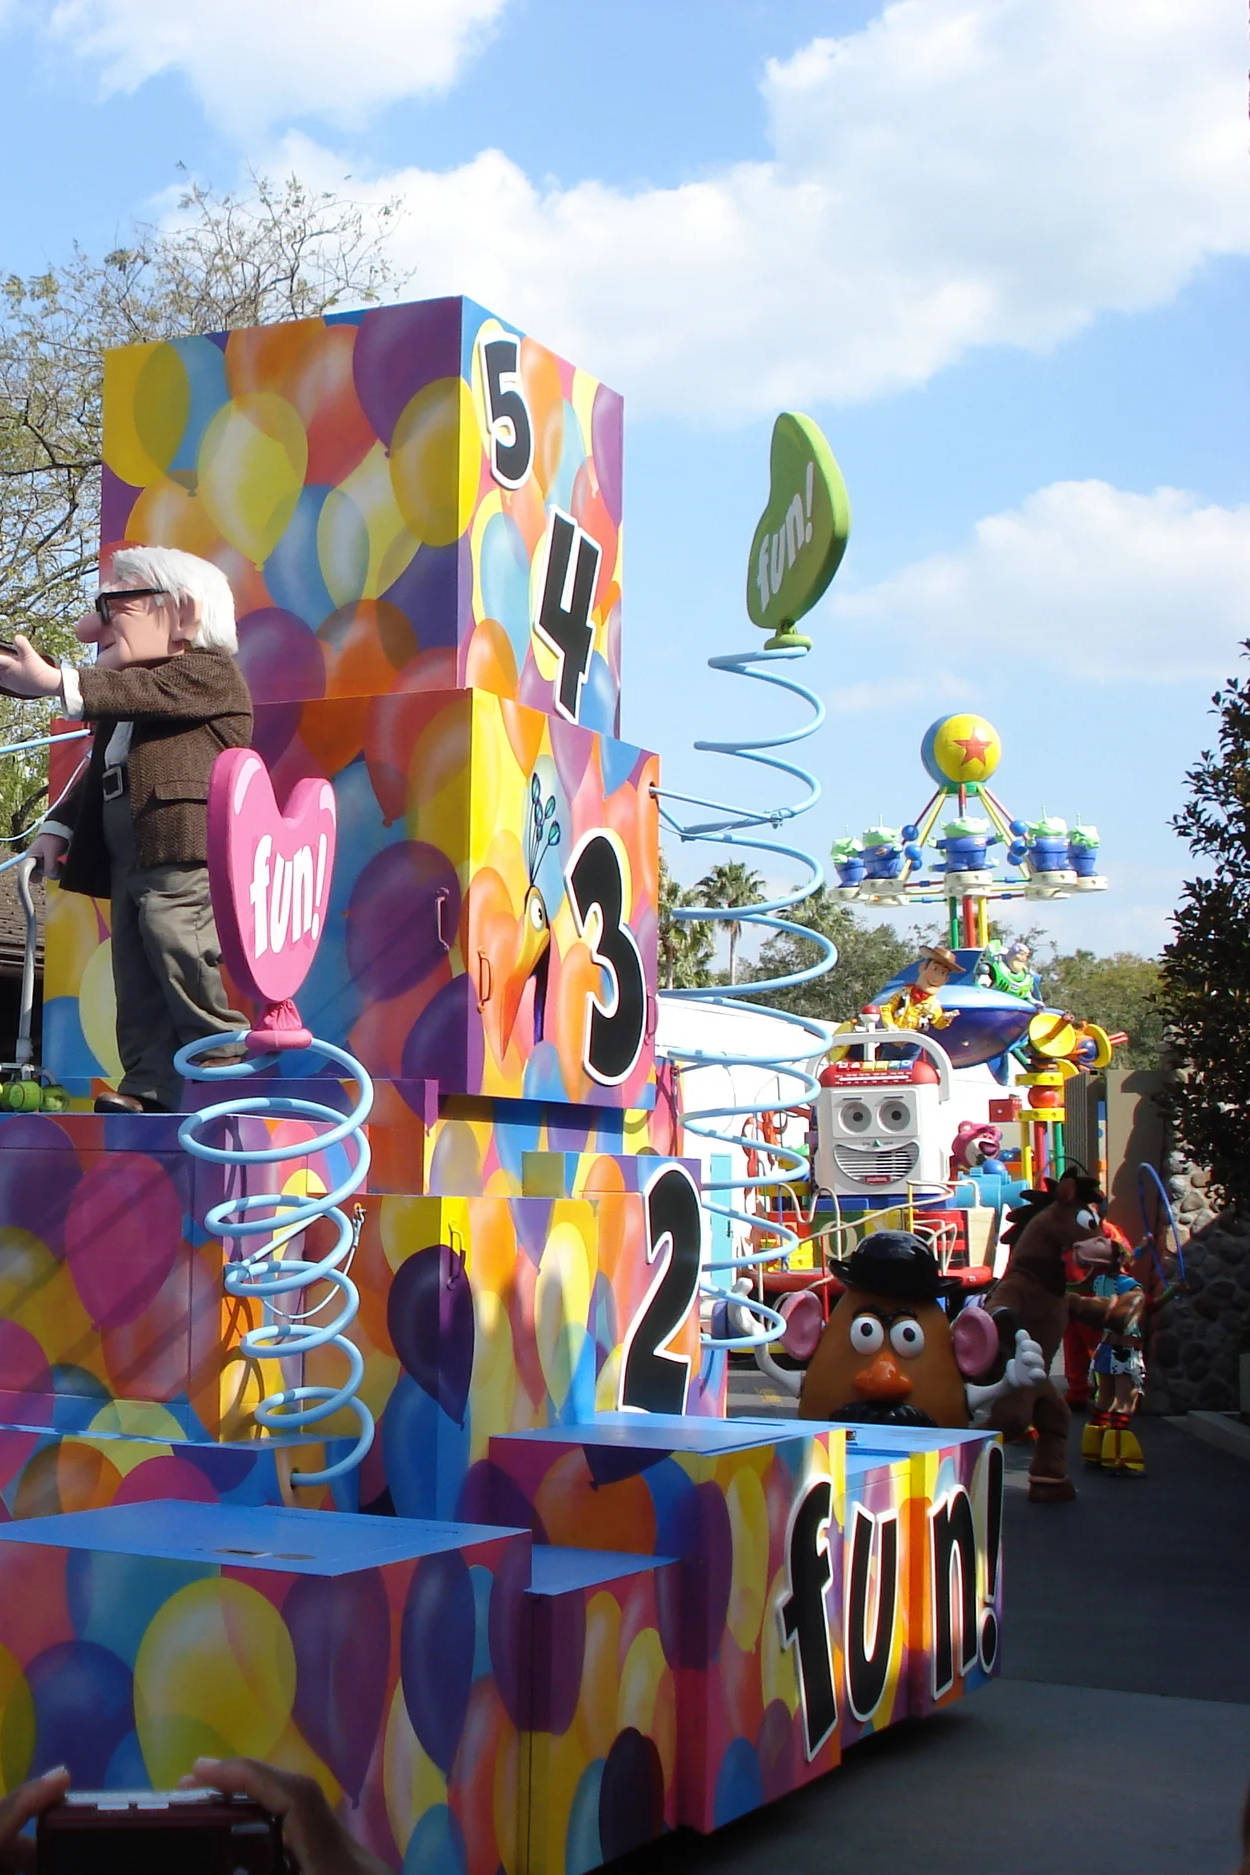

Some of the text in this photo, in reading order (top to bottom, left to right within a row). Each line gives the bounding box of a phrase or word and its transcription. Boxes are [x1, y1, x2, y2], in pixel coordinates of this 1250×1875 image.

[481, 333, 534, 488] 5
[535, 506, 601, 723] 4
[757, 461, 814, 613] fun!
[249, 833, 327, 960] fun!
[566, 829, 646, 1084] 3
[619, 1162, 700, 1416] 2
[776, 1441, 1004, 1762] fun!
